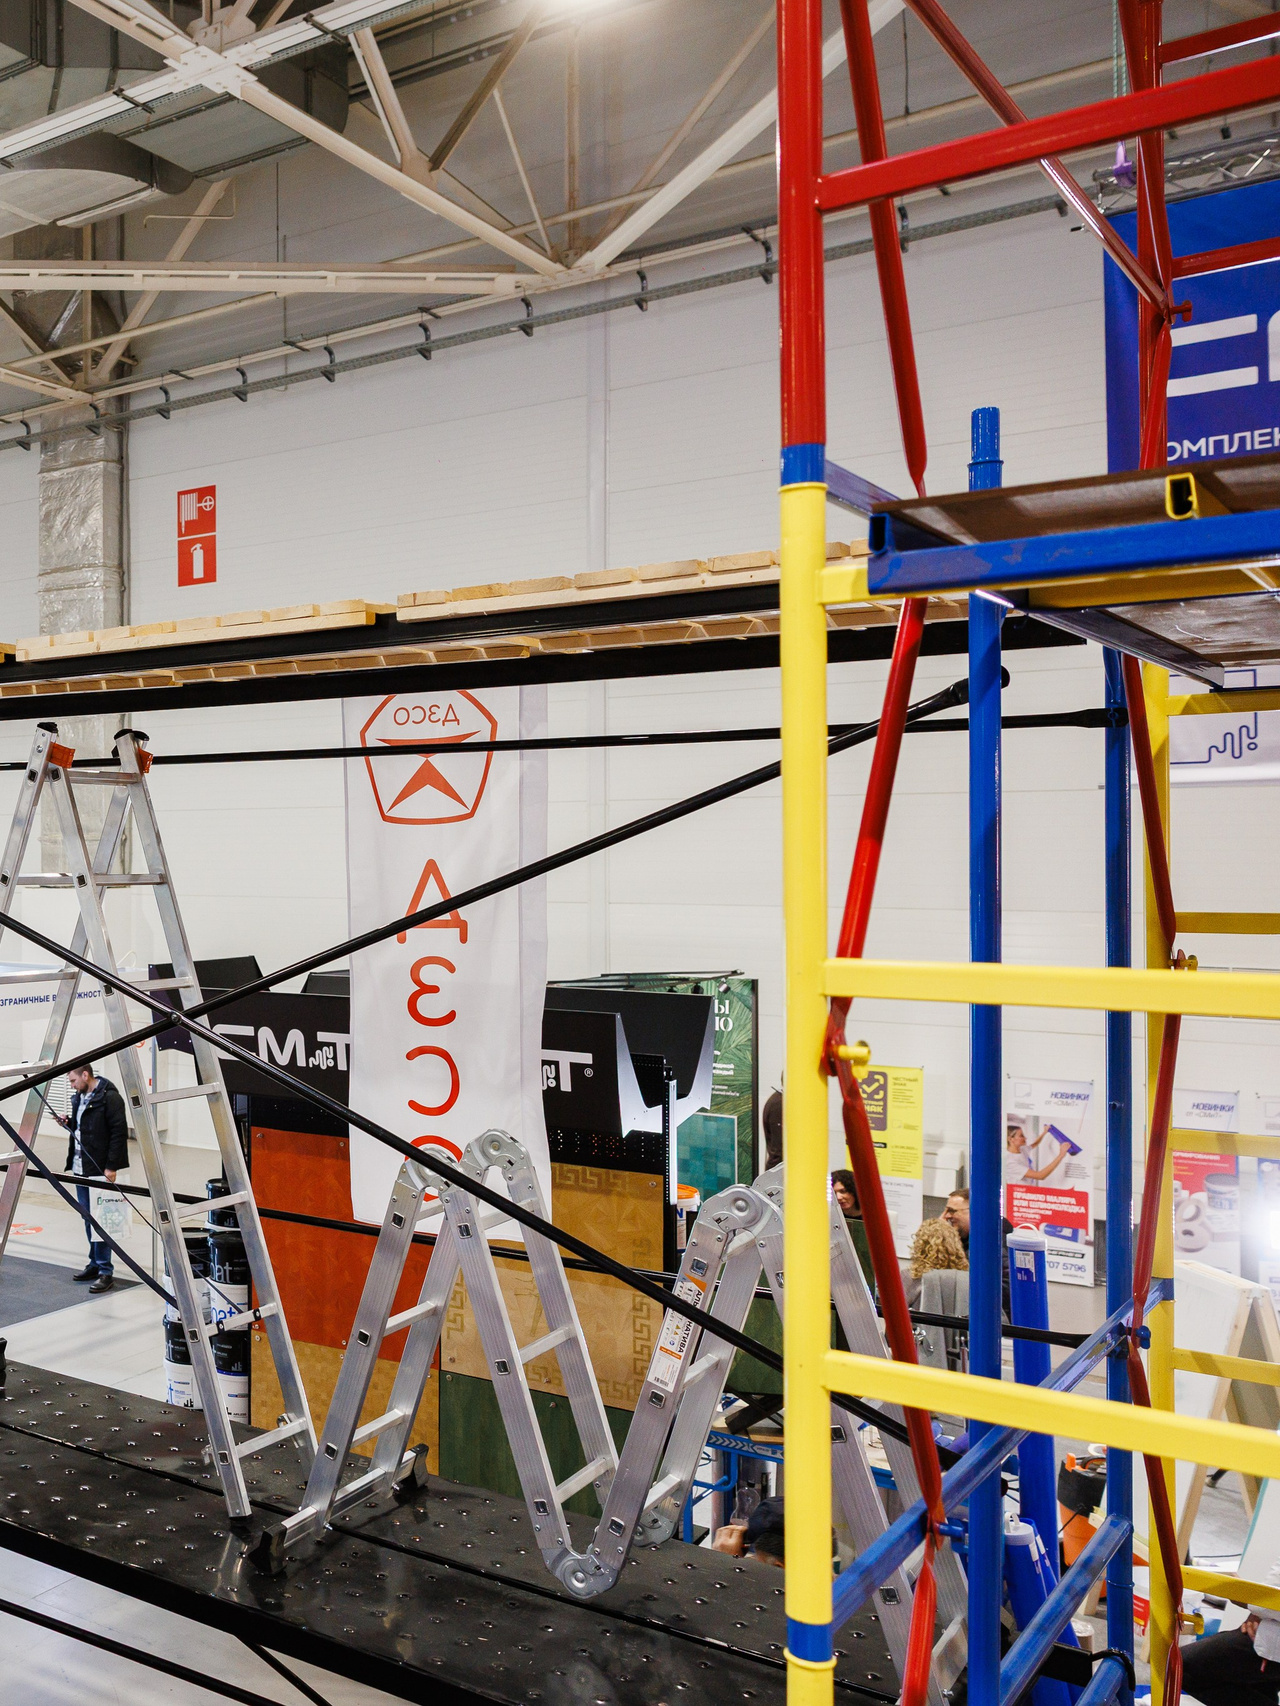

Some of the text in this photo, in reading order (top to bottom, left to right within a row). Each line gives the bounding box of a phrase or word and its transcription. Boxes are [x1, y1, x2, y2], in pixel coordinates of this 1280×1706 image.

[1166, 427, 1280, 461] ОМПЛЕ
[52, 990, 101, 1002] ВЖНОСТ
[1050, 1092, 1090, 1101] НОВИНКИ
[865, 1105, 884, 1113] НАК
[1192, 1103, 1235, 1113] НОВИНКИ
[1047, 1260, 1087, 1273] 07 5796
[678, 1289, 703, 1354] АЛЬНАТИВА
